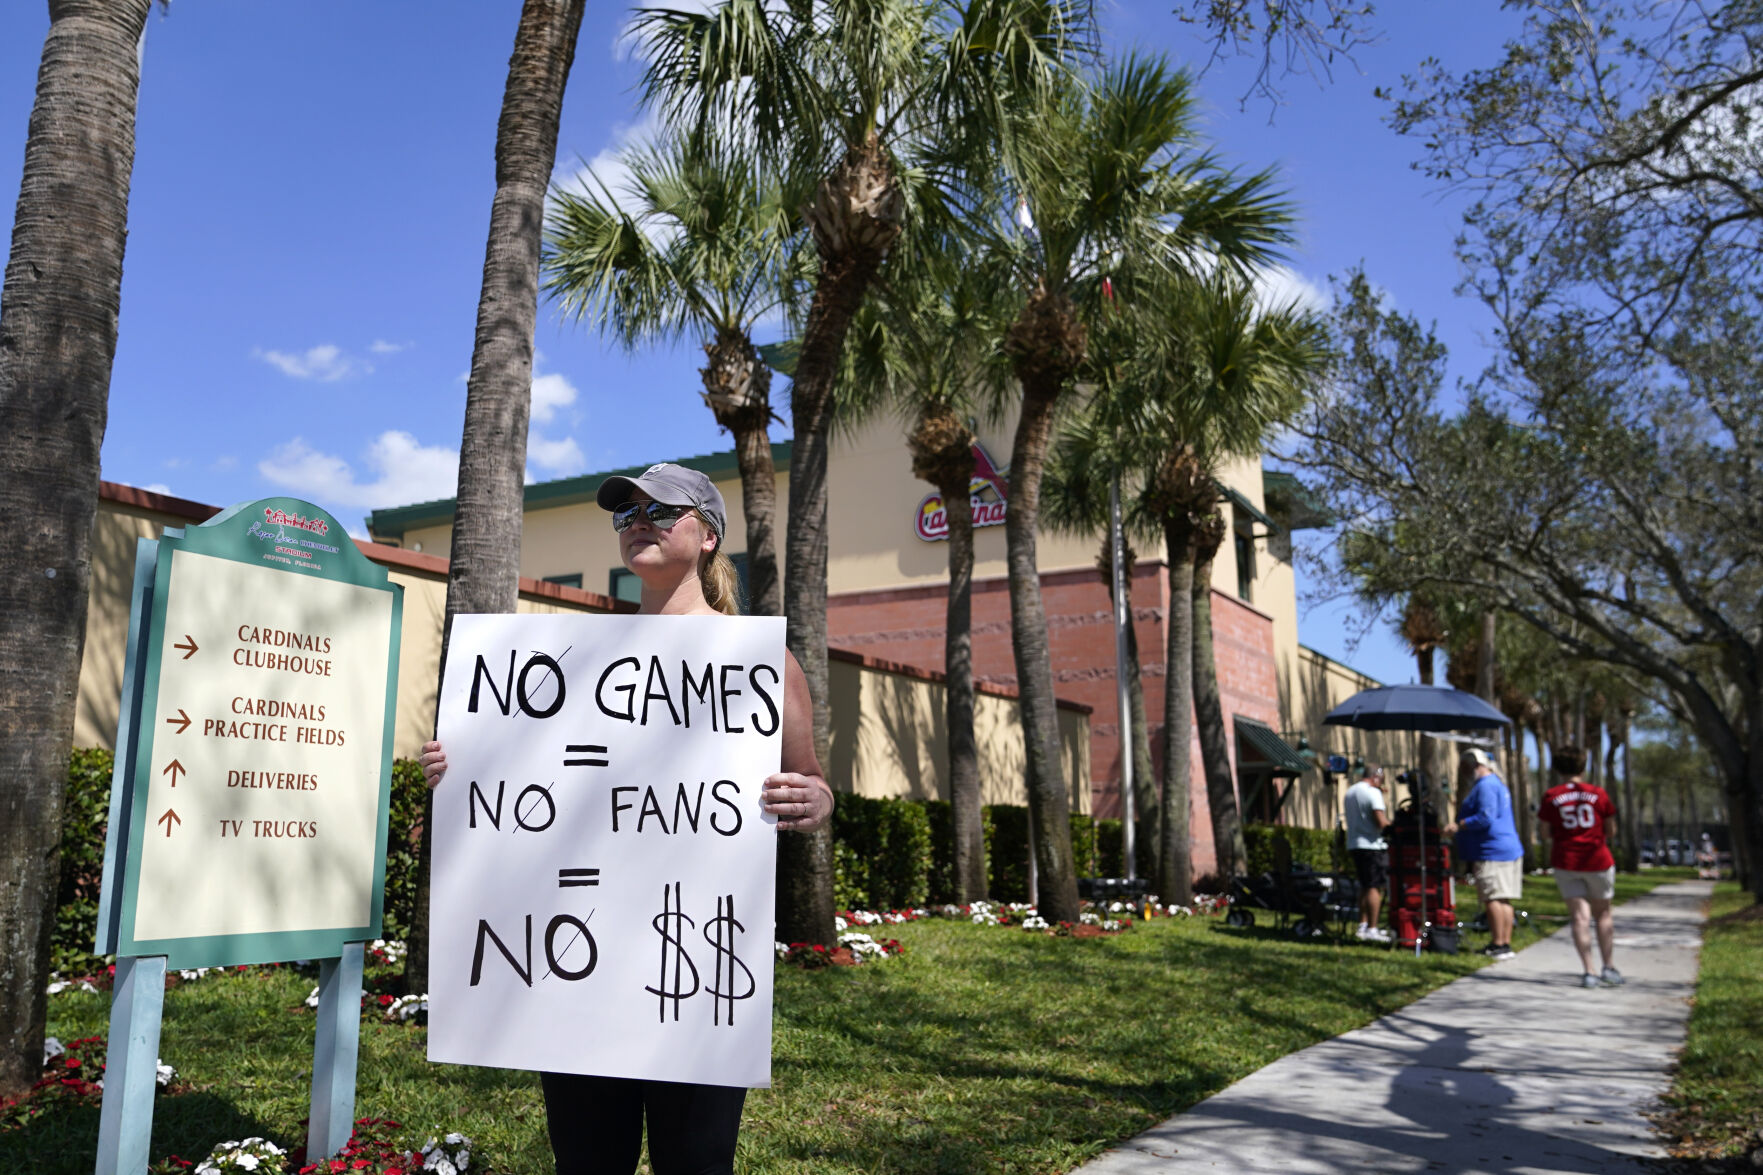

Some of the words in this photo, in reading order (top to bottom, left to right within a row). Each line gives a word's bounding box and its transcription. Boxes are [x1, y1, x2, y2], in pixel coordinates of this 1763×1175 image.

[275, 546, 312, 559] STADIUM
[238, 624, 331, 654] CARDINALS
[233, 648, 331, 677] CLUBHOUSE
[231, 696, 326, 721] CARDINALS
[594, 655, 780, 737] GAMES
[203, 719, 287, 742] PRACTICE
[296, 726, 345, 747] FIELDS
[227, 770, 318, 791] DELIVERIES
[611, 779, 743, 837] FANS
[1559, 803, 1595, 830] 50
[219, 820, 243, 837] TV
[253, 820, 317, 839] TRUCKS
